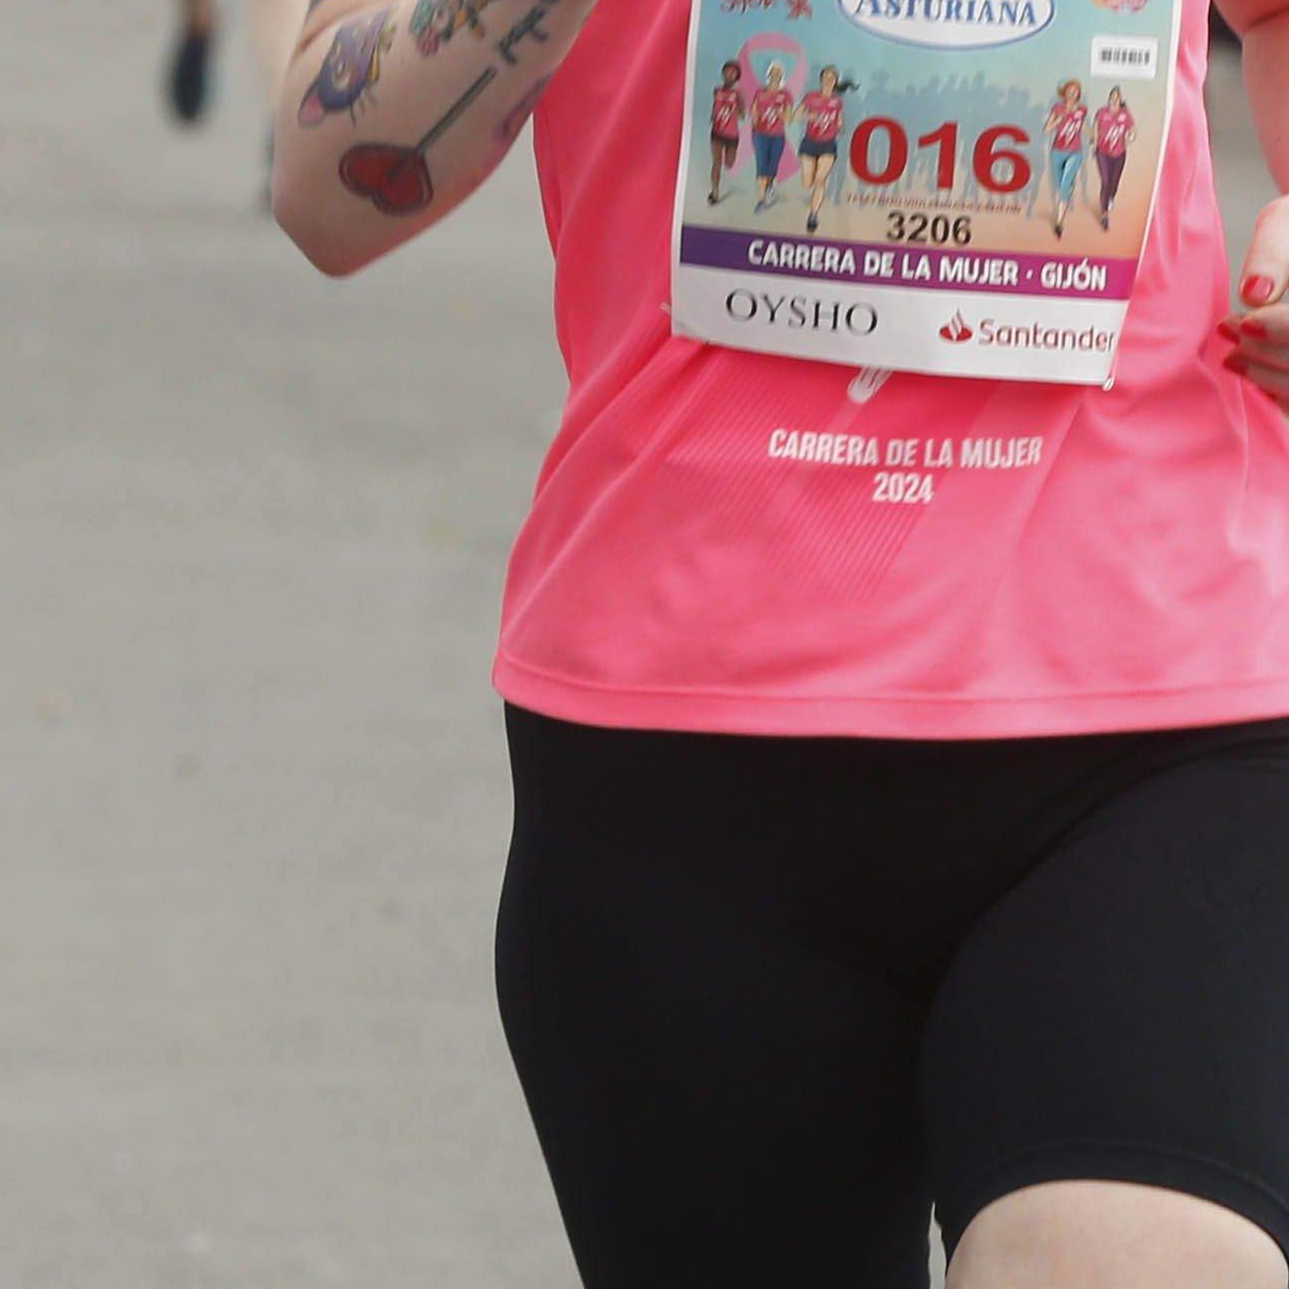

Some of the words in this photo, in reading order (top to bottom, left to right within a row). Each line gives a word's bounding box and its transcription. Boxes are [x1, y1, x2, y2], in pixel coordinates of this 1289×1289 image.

[849, 115, 1032, 195] 016
[887, 211, 972, 246] 3206
[748, 239, 855, 275] CARRERA
[864, 250, 893, 278] DE
[901, 253, 931, 281] LA
[939, 256, 1018, 286] MUJER
[1040, 258, 1106, 291] GIJÓN
[726, 288, 878, 337] OYSHO
[979, 317, 1115, 352] Santander
[768, 428, 878, 466] CARRERA
[885, 438, 918, 467] DE
[923, 439, 953, 468] LA
[960, 435, 1043, 469] MUJER
[872, 471, 935, 504] 2024
